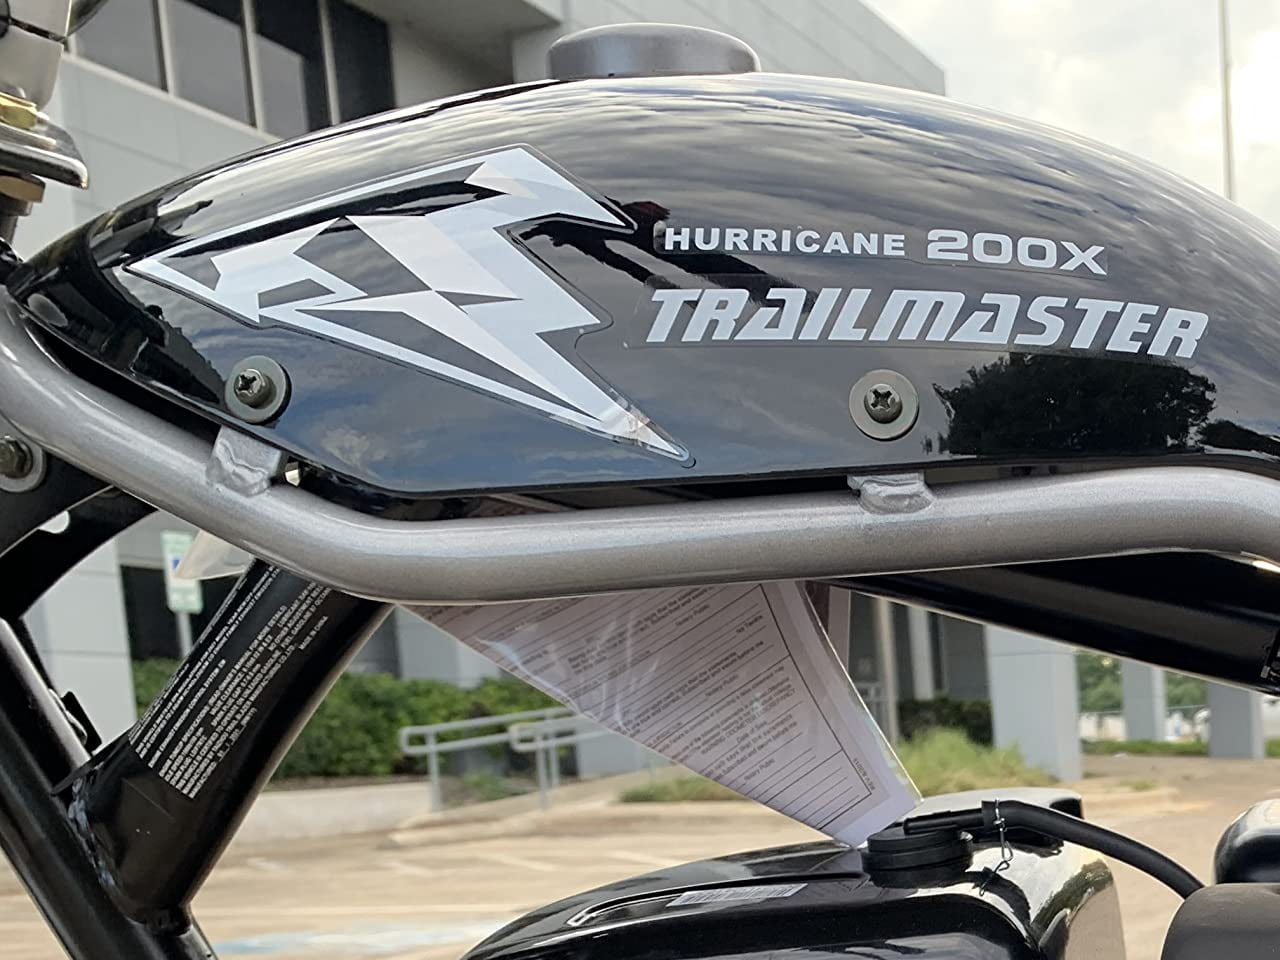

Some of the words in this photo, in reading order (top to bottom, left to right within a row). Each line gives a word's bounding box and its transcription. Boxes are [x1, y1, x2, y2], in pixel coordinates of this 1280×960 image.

[665, 227, 905, 256] HURRICANE
[927, 229, 1106, 275] 200X
[645, 288, 1209, 359] TRAILMASTER
